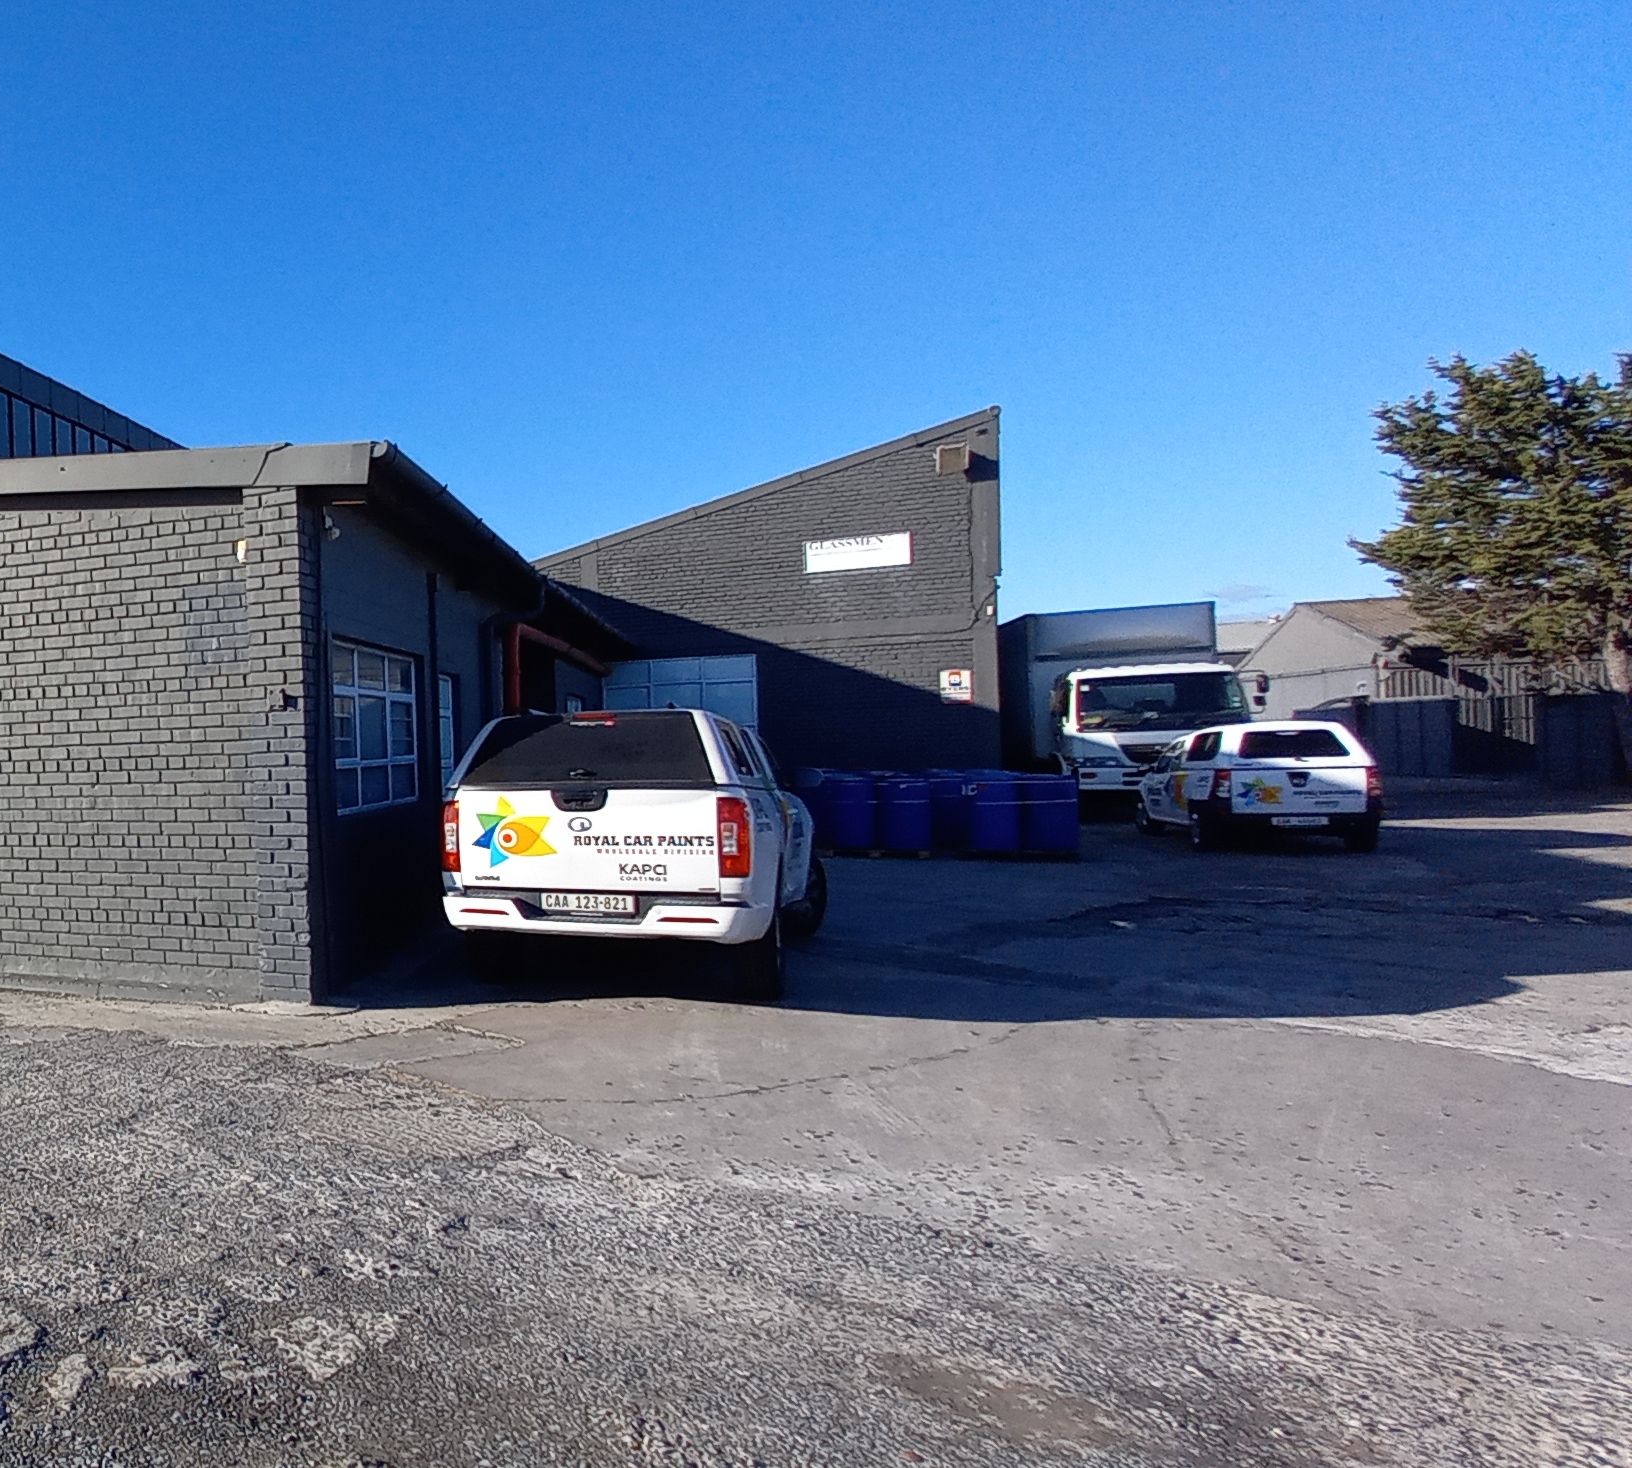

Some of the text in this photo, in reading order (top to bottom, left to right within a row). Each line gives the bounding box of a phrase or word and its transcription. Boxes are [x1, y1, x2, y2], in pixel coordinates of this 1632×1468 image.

[809, 536, 883, 551] GLASSMEN
[573, 835, 715, 847] ROYAL CAR PAINTS
[619, 863, 668, 876] KAPCI
[545, 894, 628, 911] CAA 123-821
